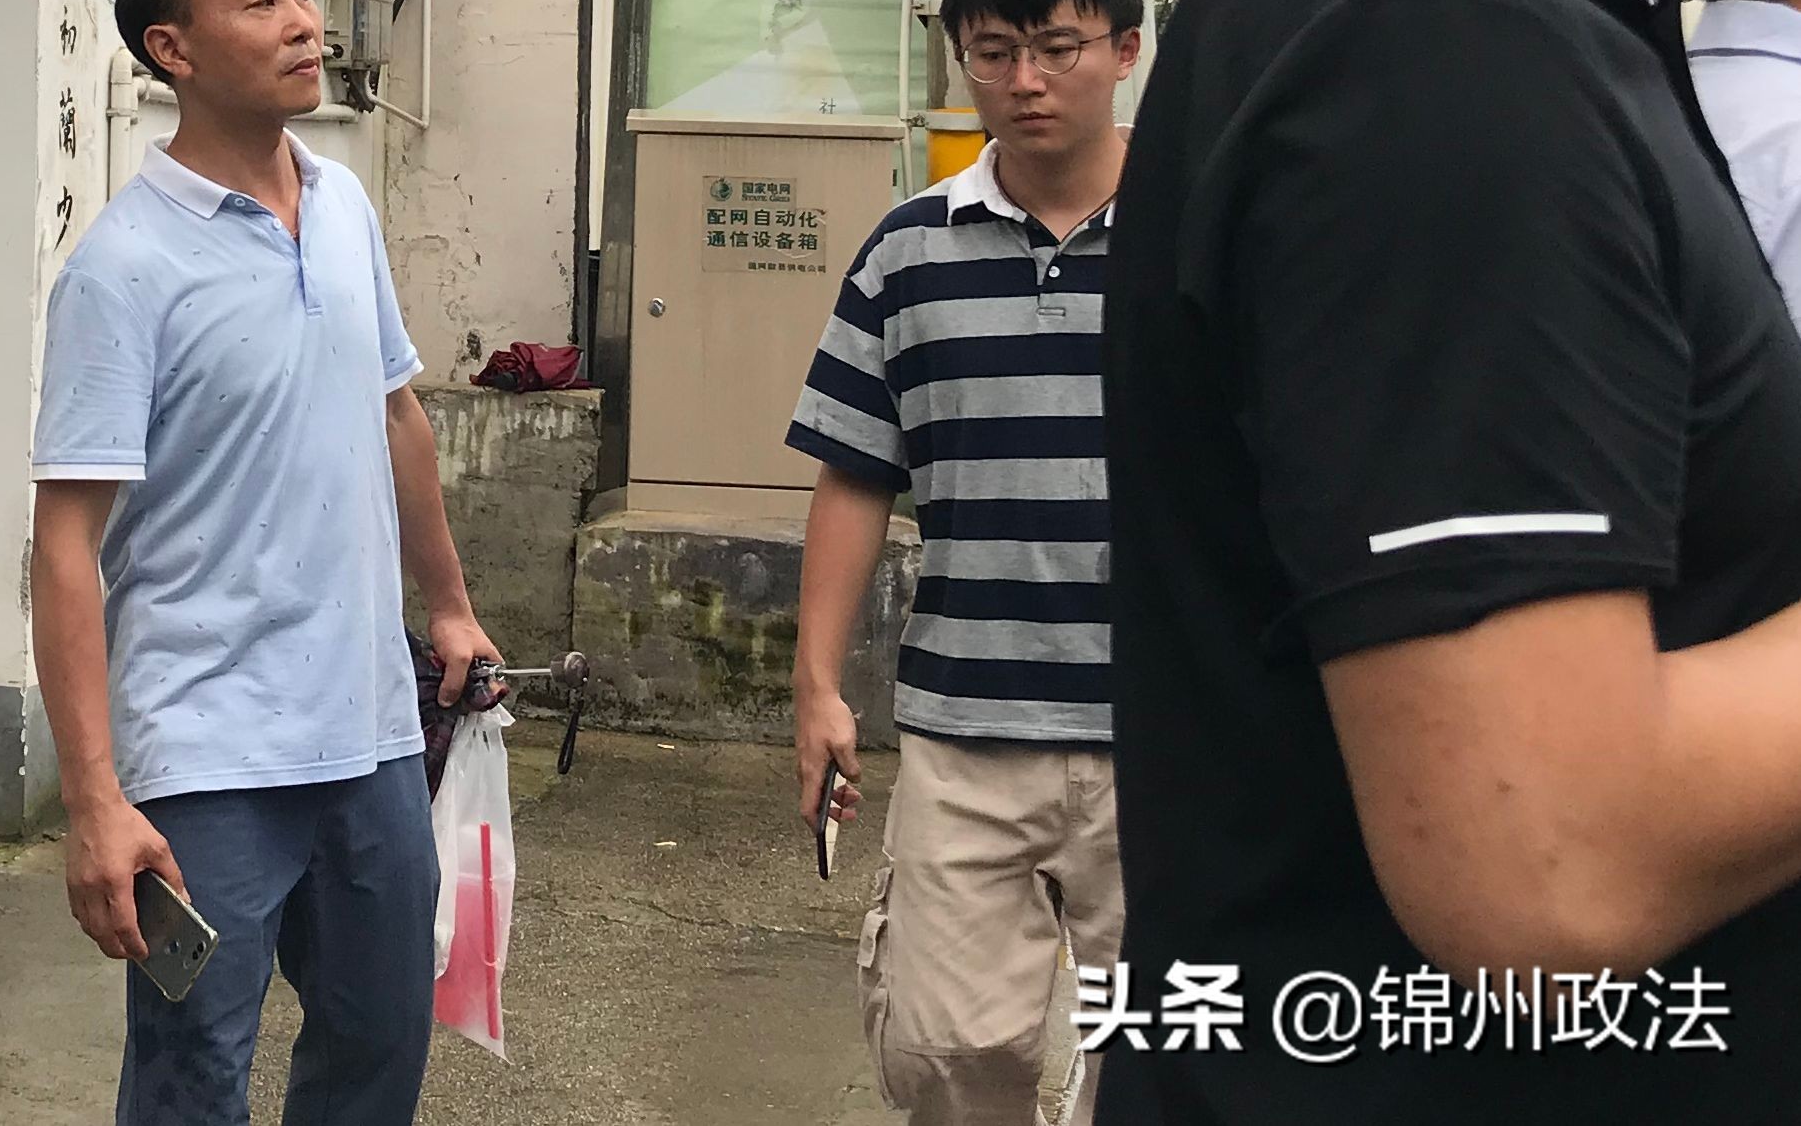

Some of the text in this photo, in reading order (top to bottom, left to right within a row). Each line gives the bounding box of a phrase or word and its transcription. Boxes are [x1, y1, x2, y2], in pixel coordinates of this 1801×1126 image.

[741, 182, 791, 194] 国家电网
[706, 208, 818, 228] 配网自动化
[706, 230, 818, 250] 通信设备箱
